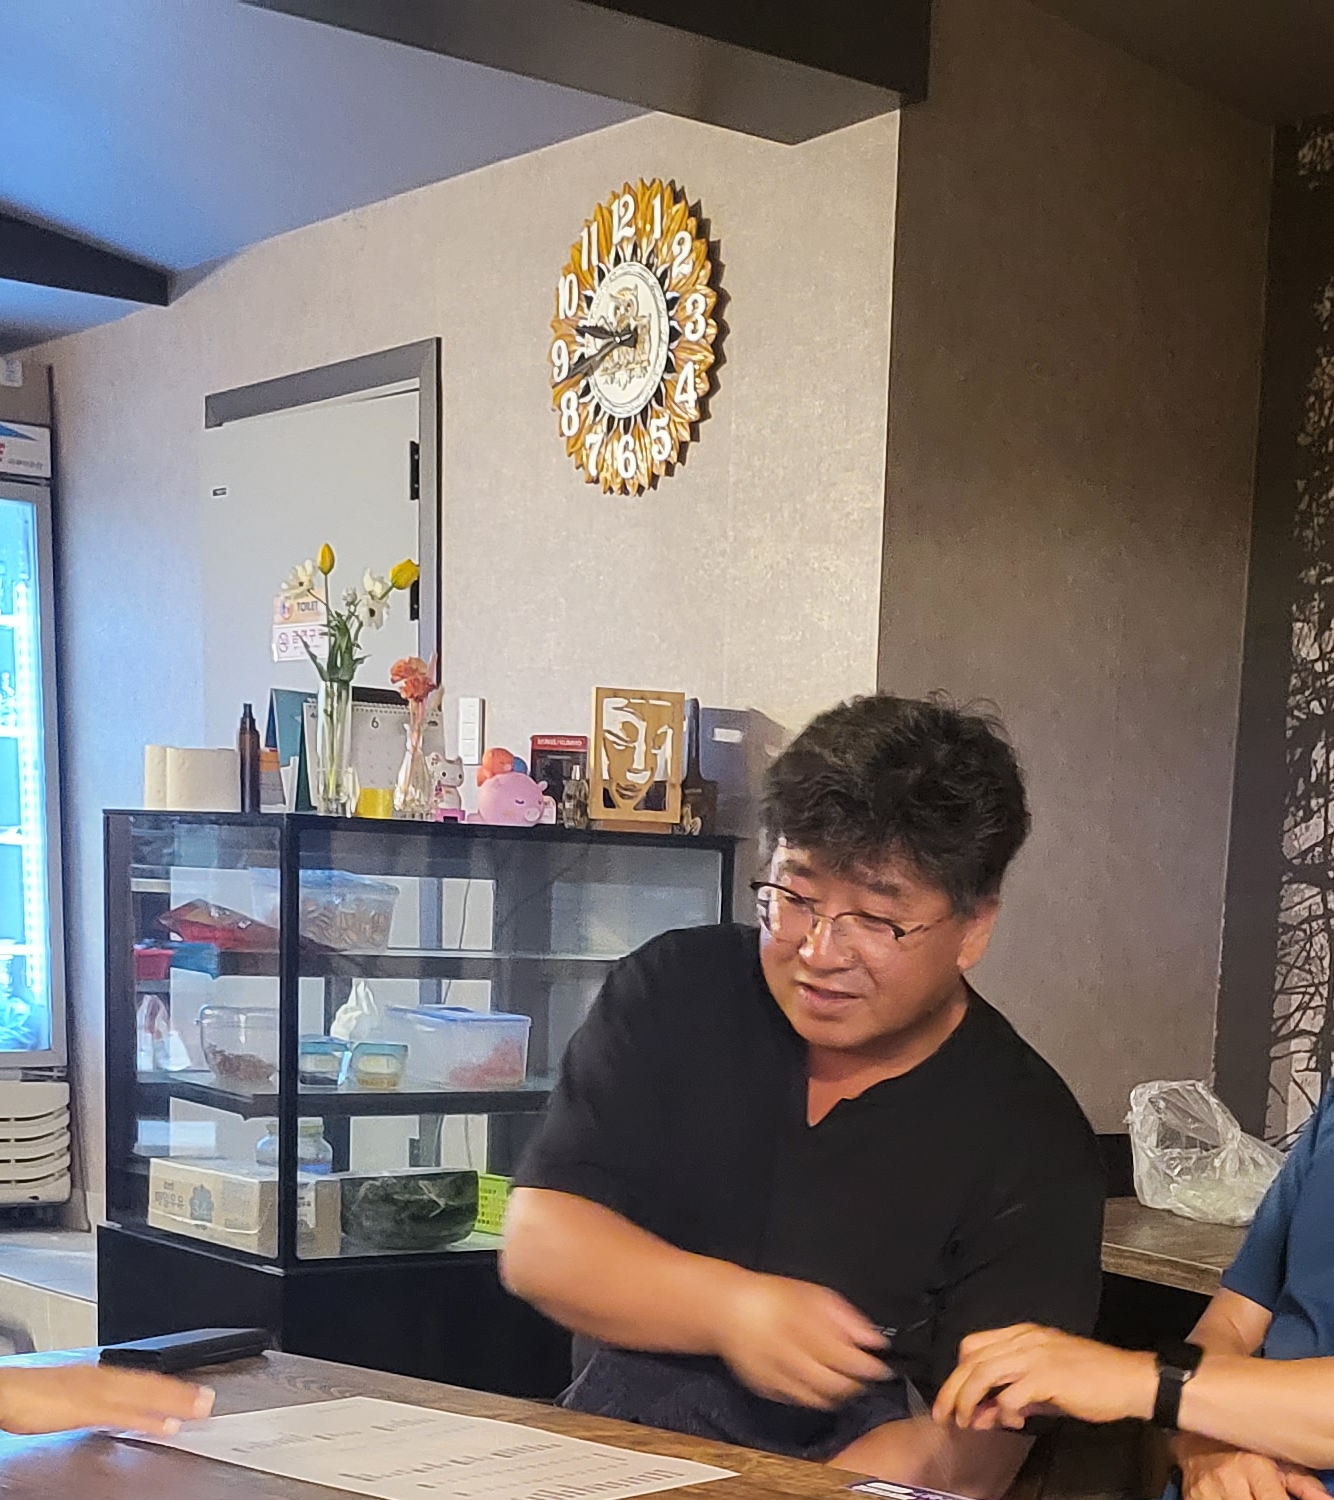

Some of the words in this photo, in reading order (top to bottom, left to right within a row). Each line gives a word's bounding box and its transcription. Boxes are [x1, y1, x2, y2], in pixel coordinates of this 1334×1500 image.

[611, 193, 635, 245] 12
[652, 193, 662, 240] 1
[580, 221, 599, 270] 11
[672, 231, 694, 278] 2
[558, 273, 579, 319] 10
[685, 293, 706, 342] 3
[551, 339, 570, 382] 9
[674, 361, 697, 407] 4
[560, 390, 579, 437] 8
[585, 432, 604, 477] 7
[617, 434, 637, 479] 6
[650, 415, 672, 461] 5
[371, 716, 380, 729] 6
